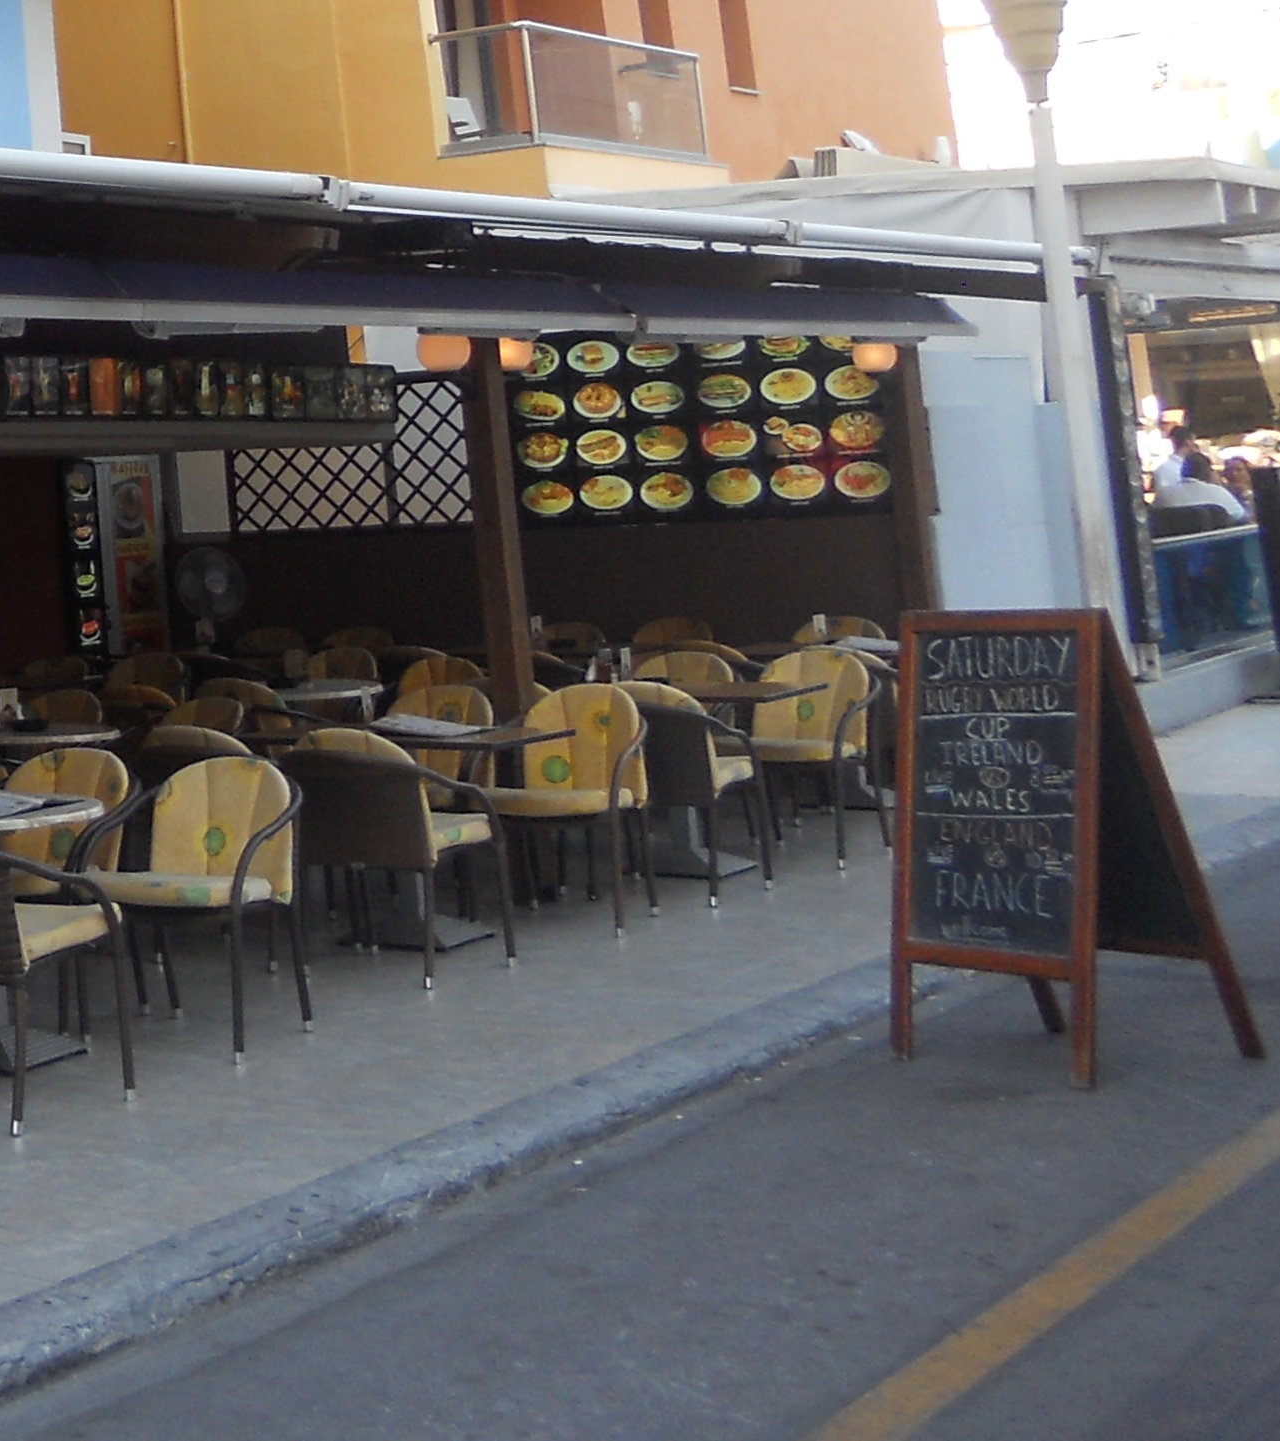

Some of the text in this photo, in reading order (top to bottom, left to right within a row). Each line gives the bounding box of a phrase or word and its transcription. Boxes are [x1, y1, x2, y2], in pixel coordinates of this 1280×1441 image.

[926, 635, 1071, 680] SATURDAY
[990, 684, 1060, 712] WORLD
[965, 717, 1011, 742] CUP
[940, 740, 1044, 766] IRELAND
[948, 788, 1031, 813] WALES
[940, 818, 1053, 850] ENGLAND
[937, 869, 1053, 919] FRANCE
